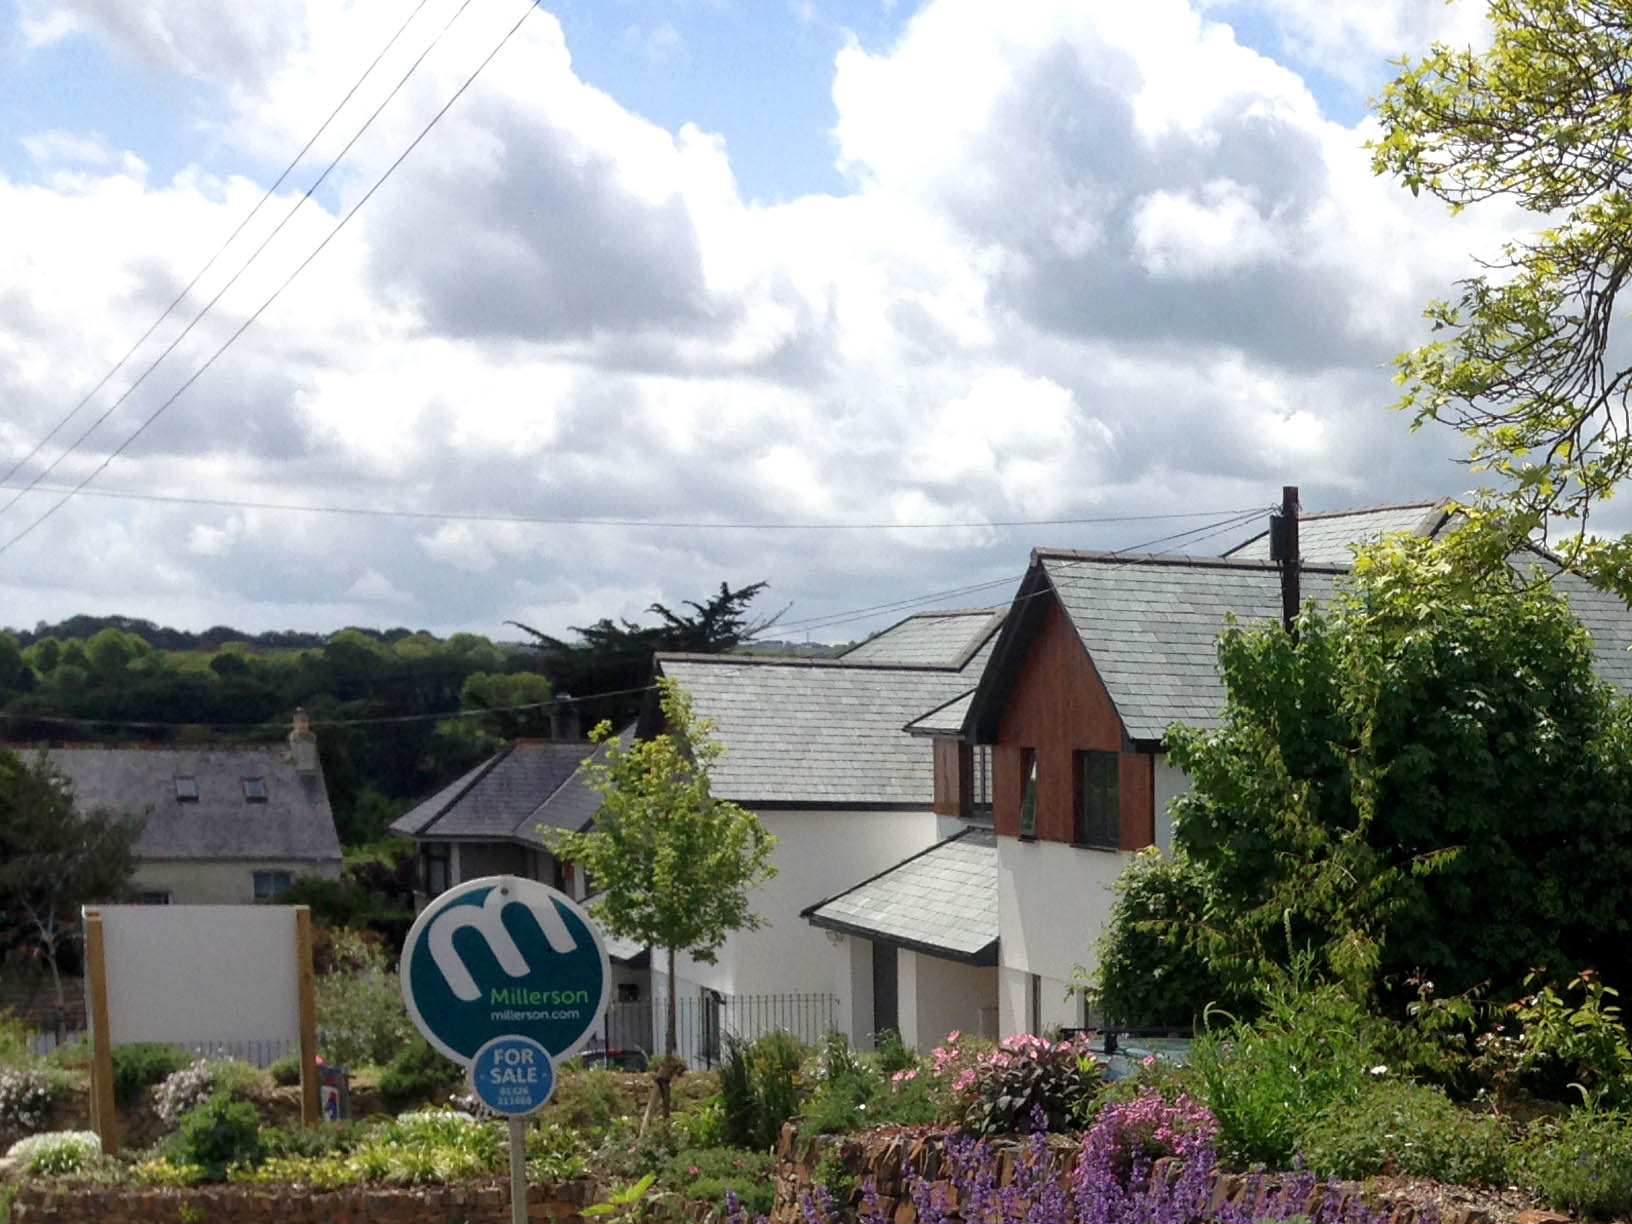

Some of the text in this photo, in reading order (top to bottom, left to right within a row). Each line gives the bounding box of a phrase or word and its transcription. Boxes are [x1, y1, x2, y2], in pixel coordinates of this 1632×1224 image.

[490, 988, 588, 1005] Millerson
[490, 1009, 580, 1020] millerson.com
[493, 1048, 534, 1065] FOR
[489, 1067, 538, 1084] SALE
